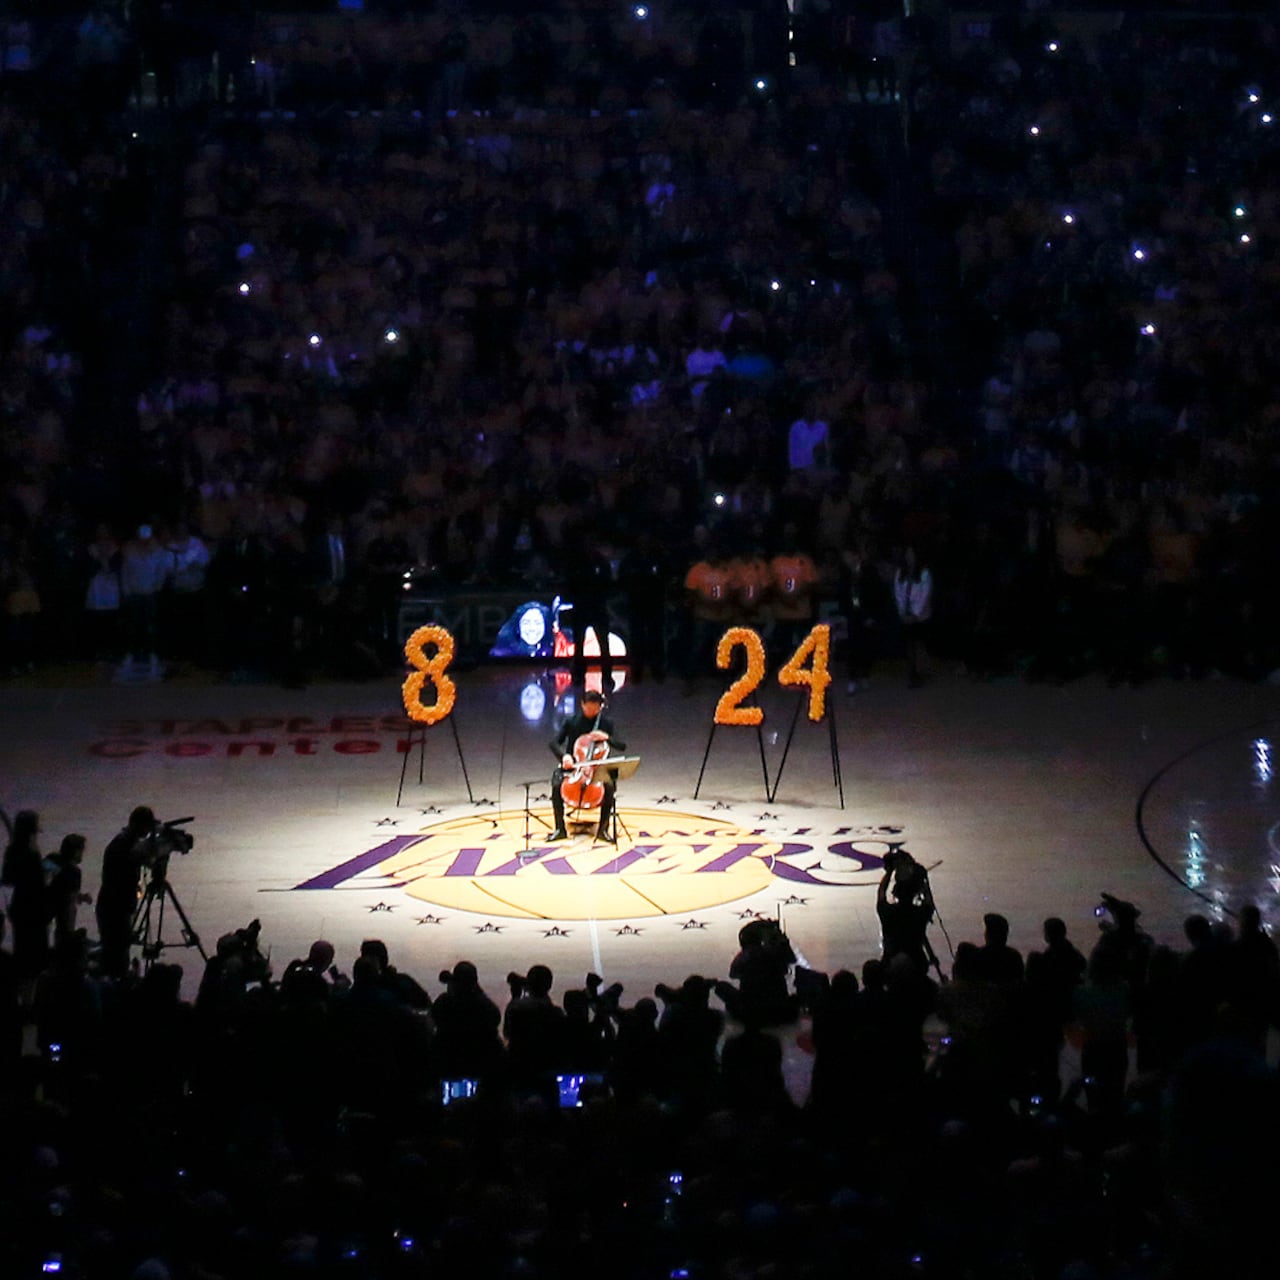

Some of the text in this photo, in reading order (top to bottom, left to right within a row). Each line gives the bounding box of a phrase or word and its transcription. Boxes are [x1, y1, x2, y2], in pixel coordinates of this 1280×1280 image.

[401, 623, 457, 725] 8
[88, 738, 427, 759] Center
[256, 832, 906, 893] LAKERS
